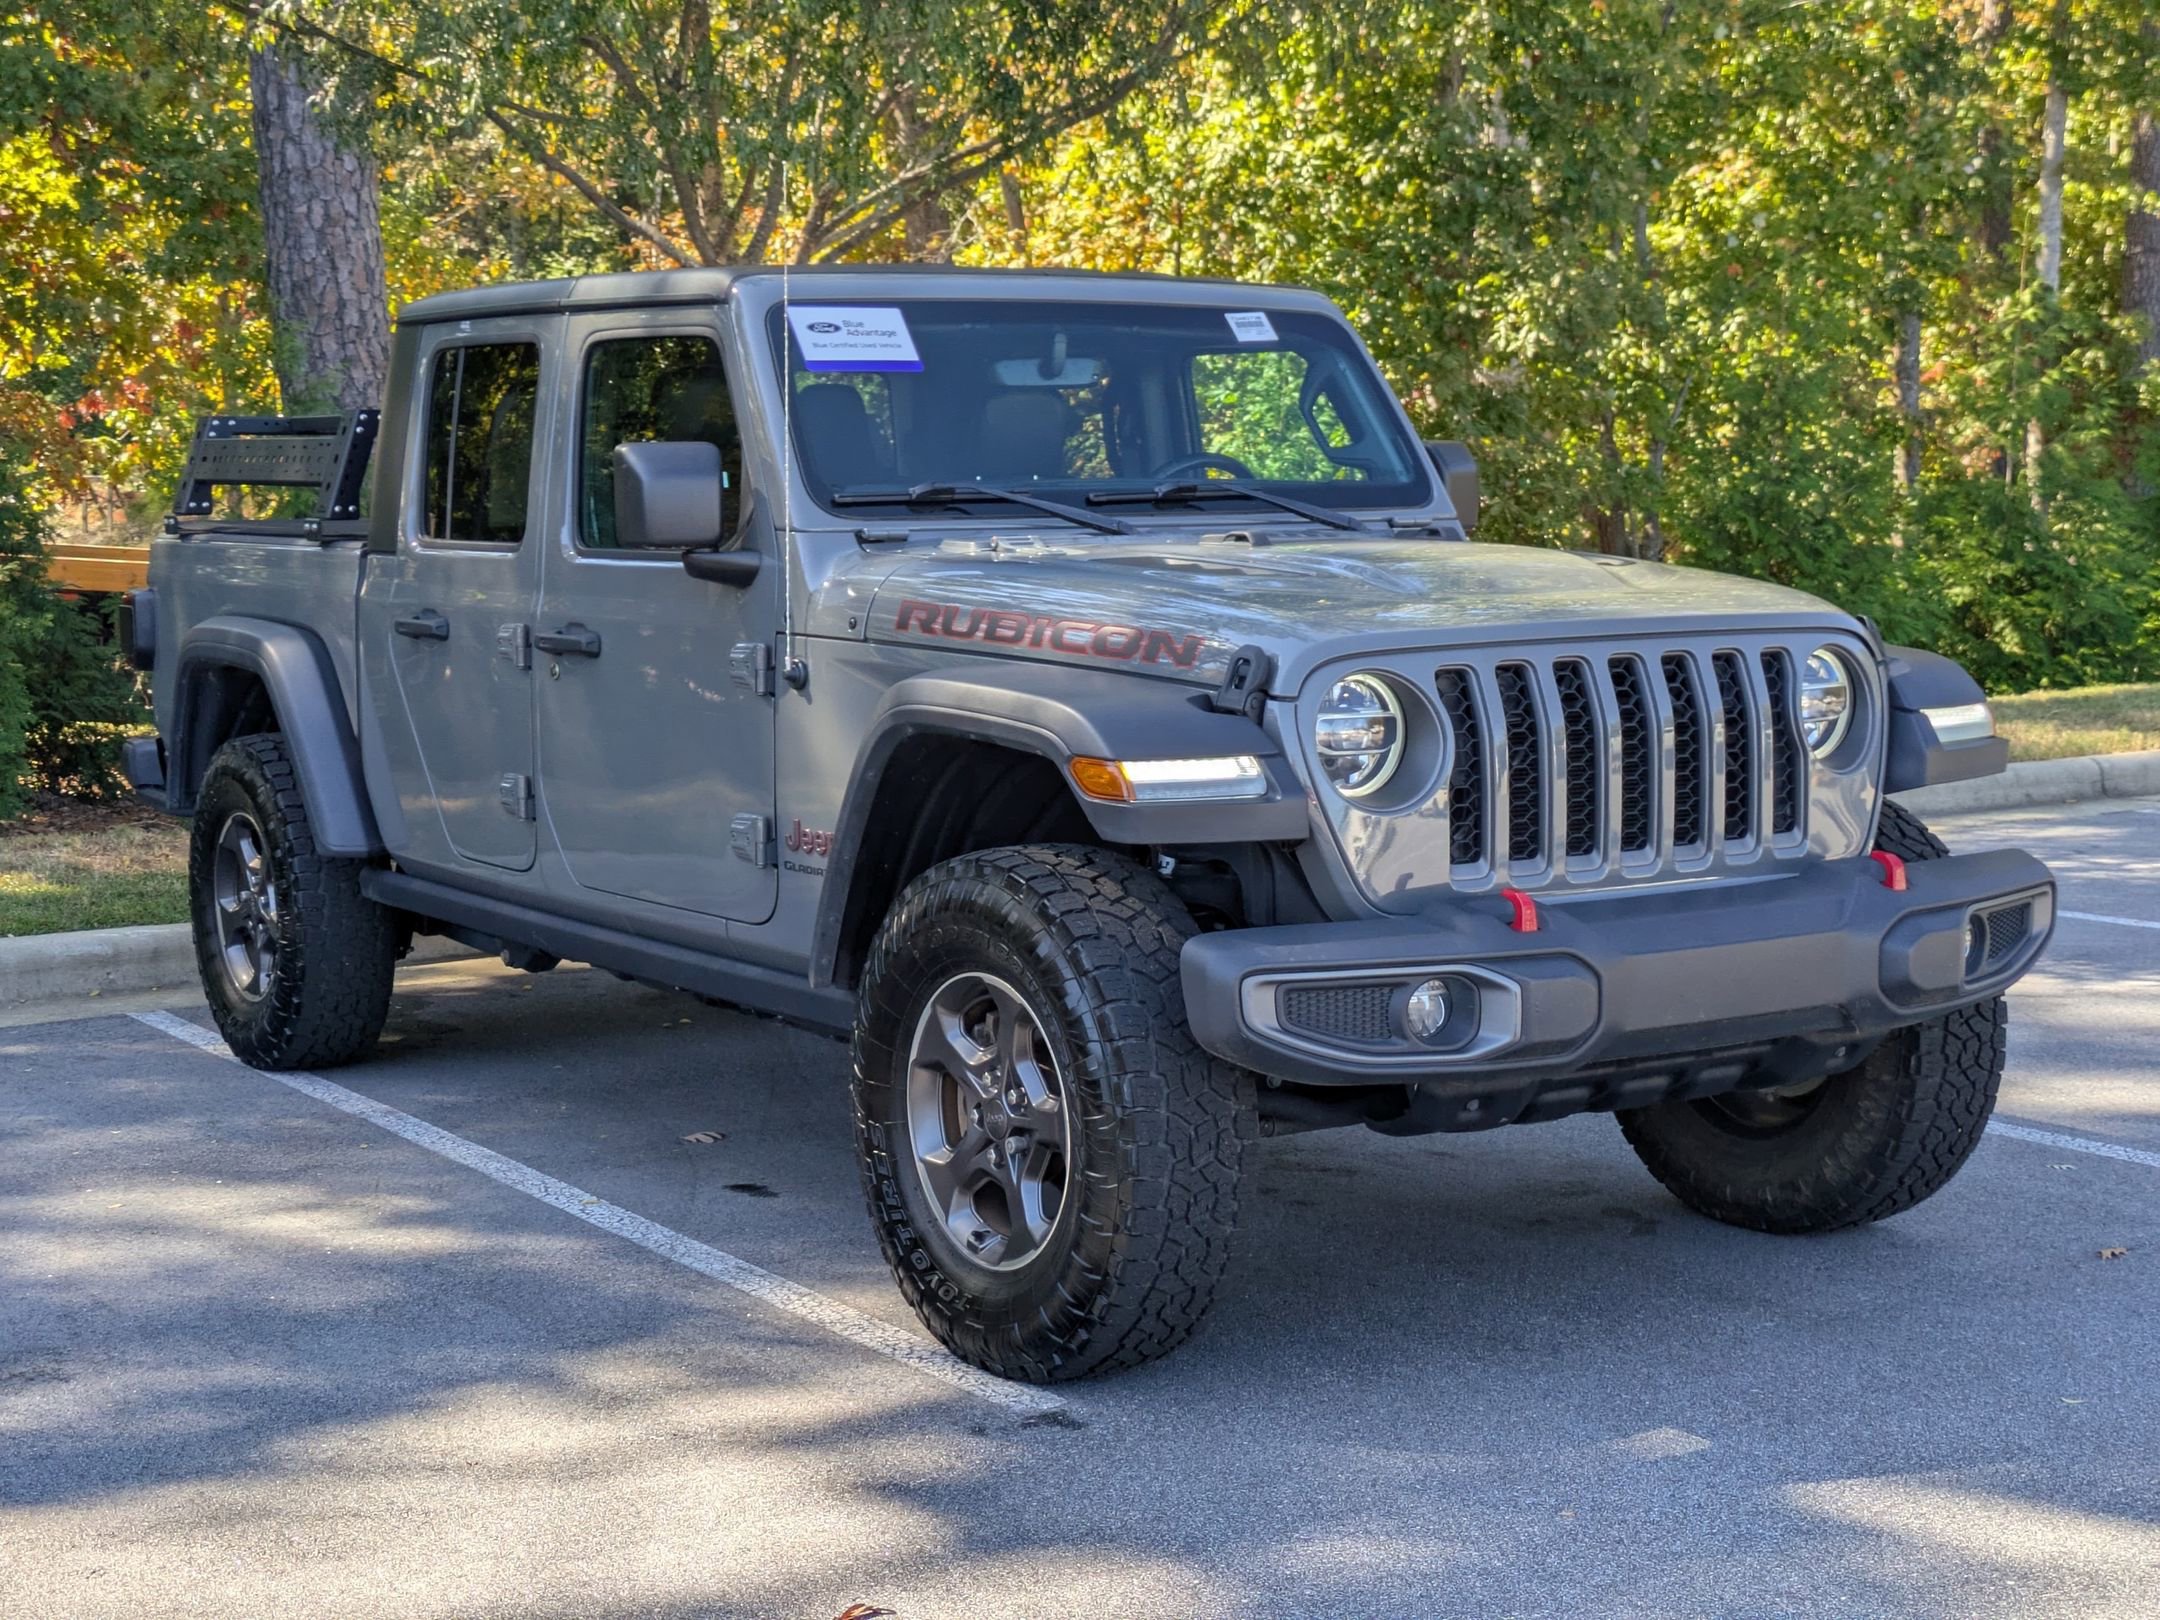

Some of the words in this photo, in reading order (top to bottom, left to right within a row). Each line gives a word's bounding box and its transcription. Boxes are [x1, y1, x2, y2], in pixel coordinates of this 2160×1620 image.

[842, 320, 864, 328] Blue
[846, 329, 897, 338] Advantage
[896, 600, 1205, 669] RUBICON
[784, 861, 828, 876] GLADIA
[867, 1119, 915, 1246] TIRES
[909, 1248, 974, 1312] TOYO
